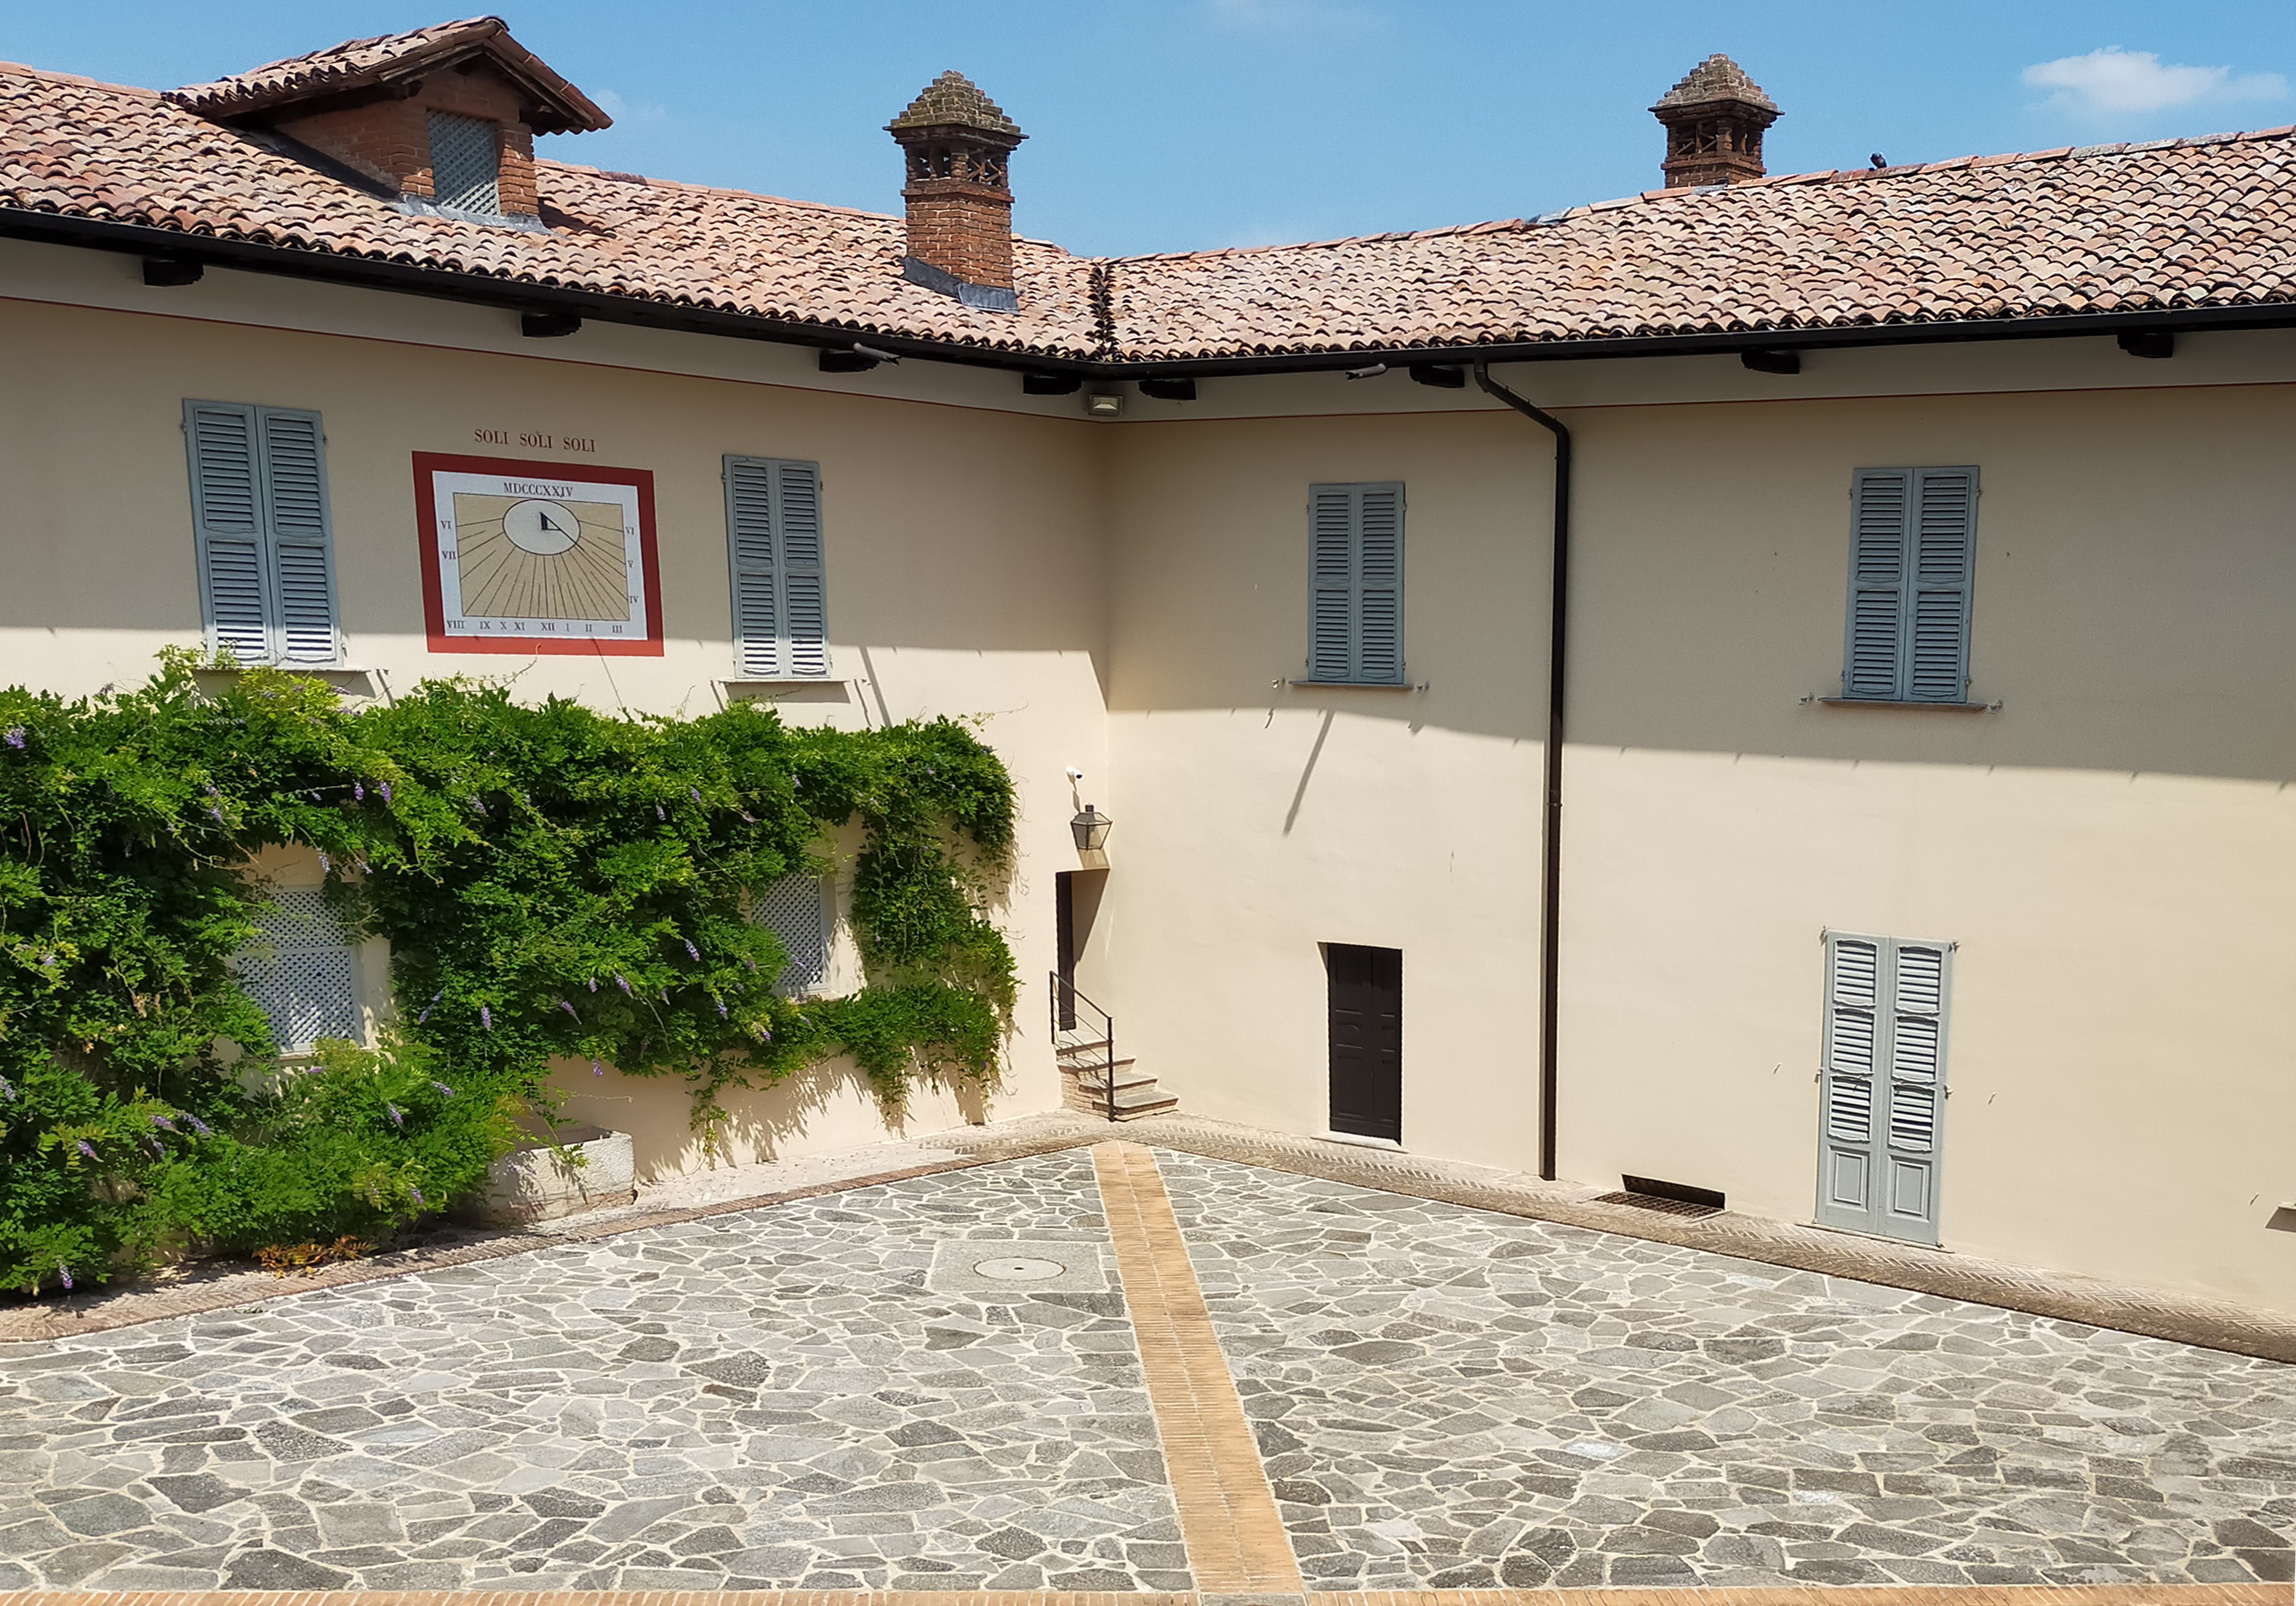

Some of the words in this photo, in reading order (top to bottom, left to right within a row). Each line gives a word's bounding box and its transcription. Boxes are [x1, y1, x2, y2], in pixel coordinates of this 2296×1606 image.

[475, 428, 509, 445] SOLI
[519, 433, 553, 449] SOLI
[563, 437, 596, 452] SOLI
[503, 482, 573, 498] MDCCCXXIV
[441, 520, 452, 529] VI
[625, 526, 635, 535] VI
[442, 550, 457, 560] VII
[628, 560, 634, 568] V
[629, 595, 639, 604] IV
[446, 620, 465, 629] VIII
[479, 620, 491, 629] IX
[500, 621, 508, 630] X
[514, 621, 526, 630] XI
[541, 622, 555, 631] XII
[565, 623, 570, 632] I
[585, 624, 593, 632] II
[612, 624, 622, 633] III
